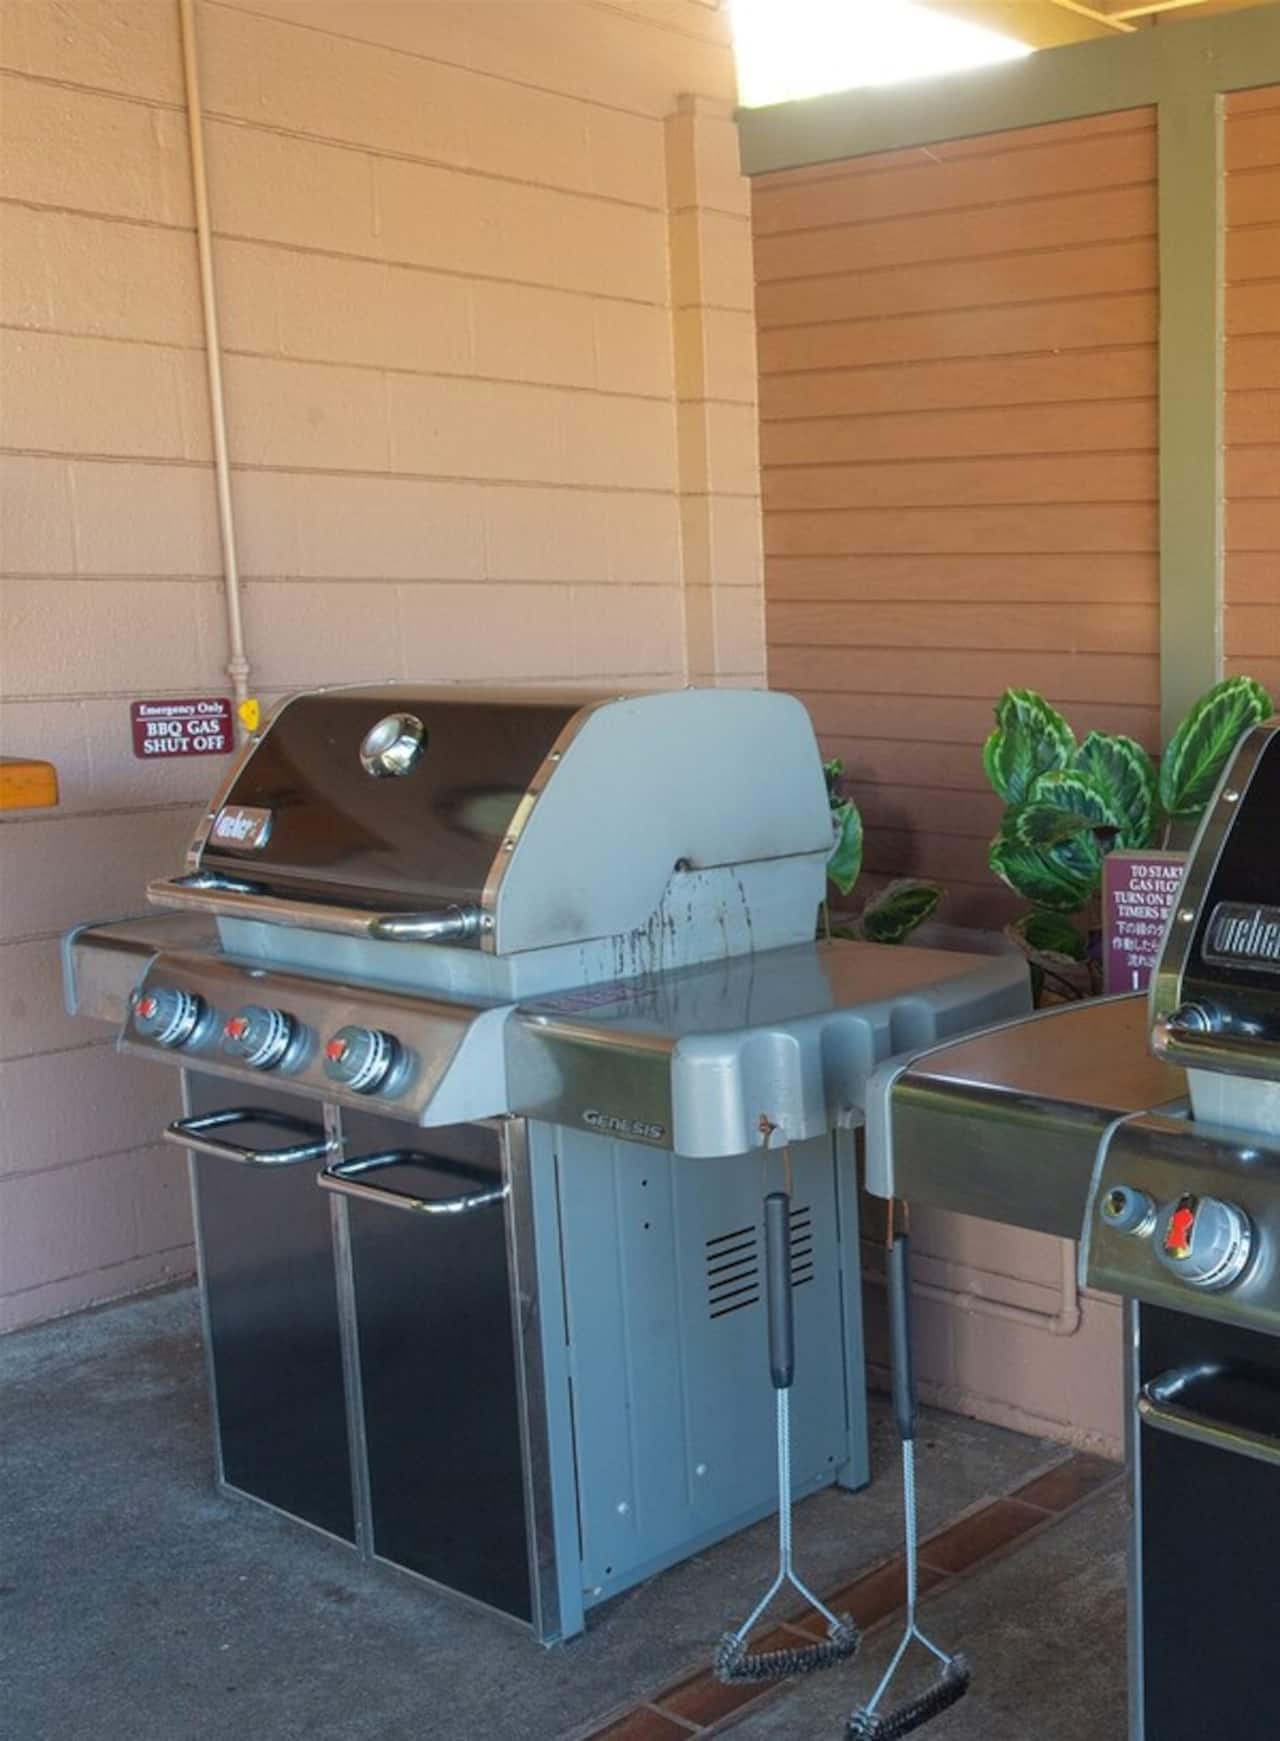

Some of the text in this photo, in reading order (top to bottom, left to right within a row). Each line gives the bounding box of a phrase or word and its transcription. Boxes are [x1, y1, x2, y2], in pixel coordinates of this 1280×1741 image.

[139, 702, 224, 717] Emergency Only
[146, 719, 220, 737] BBQ GAS
[143, 735, 224, 754] SHUT OFF
[1131, 865, 1148, 878] TO
[1129, 878, 1180, 893] GAS FLO
[1113, 890, 1145, 904] TURN
[1146, 892, 1165, 906] ON
[1117, 905, 1159, 919] TIMERS
